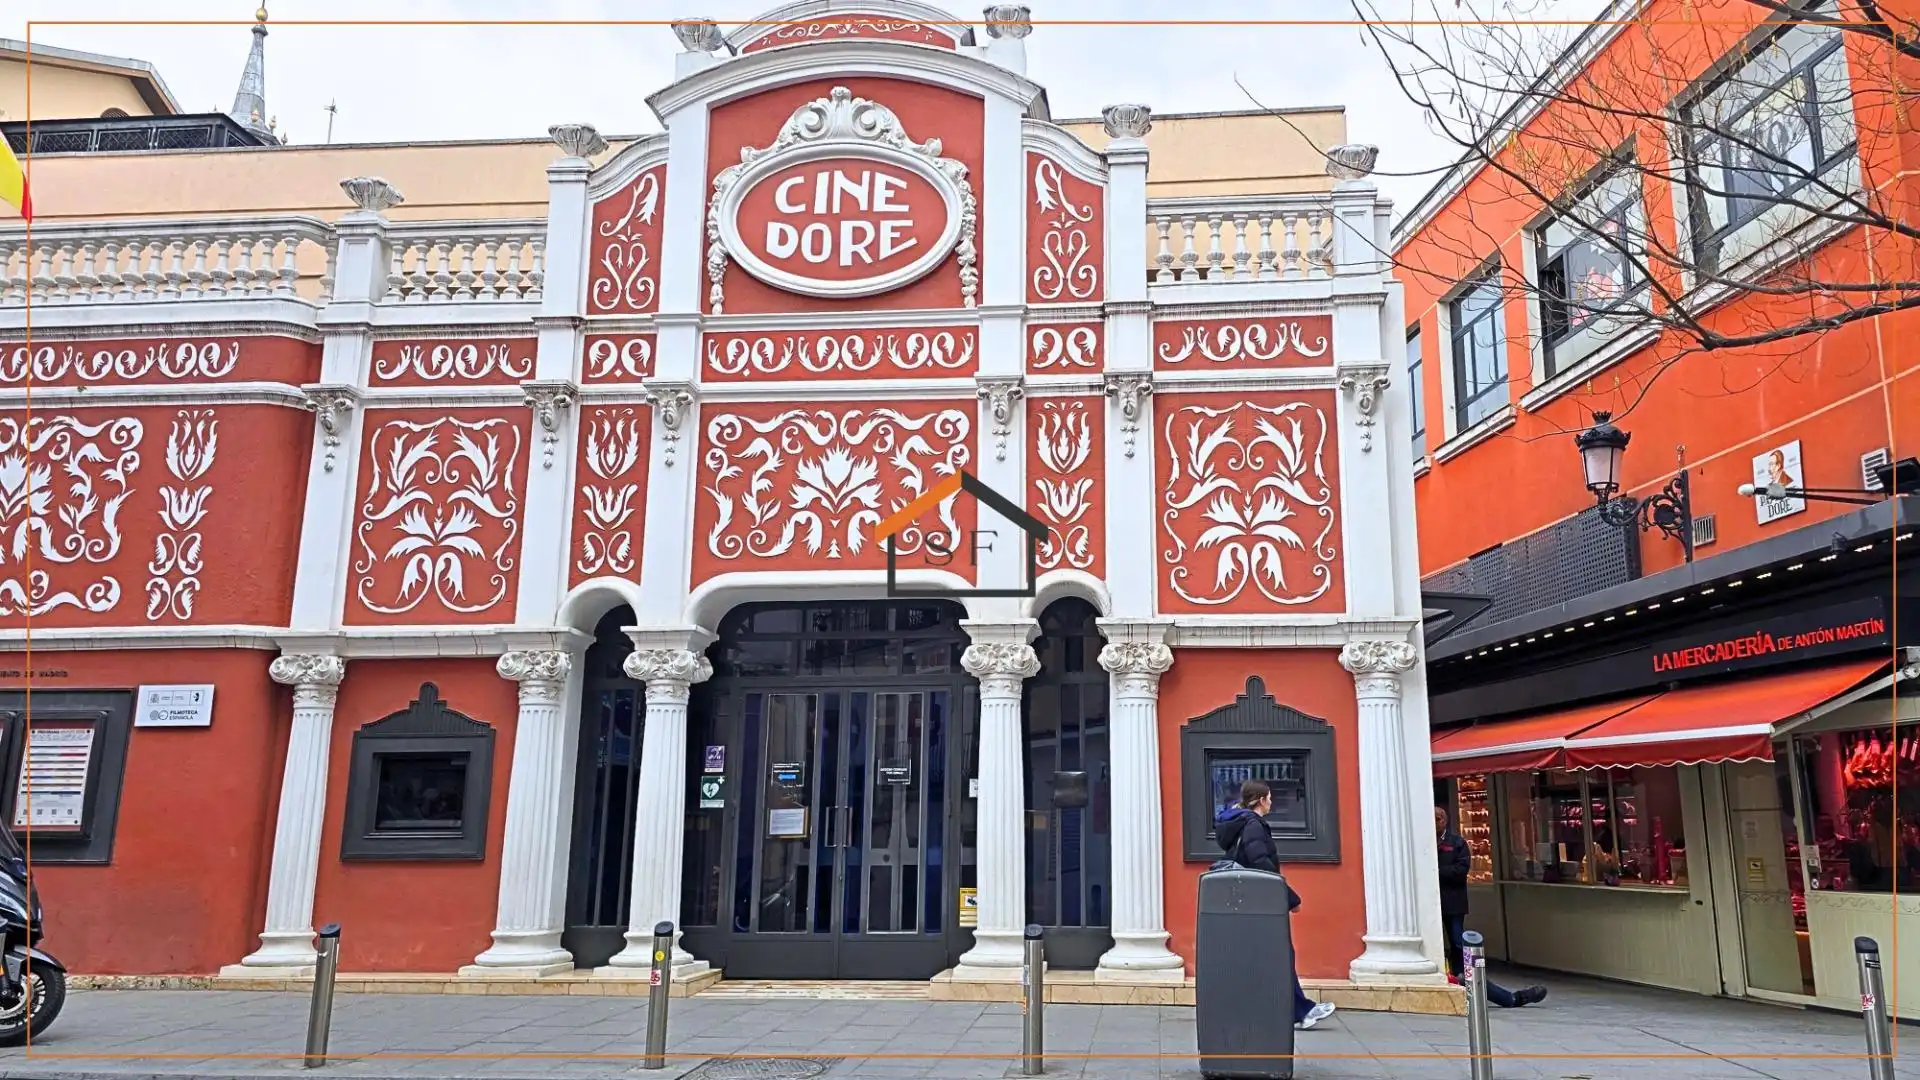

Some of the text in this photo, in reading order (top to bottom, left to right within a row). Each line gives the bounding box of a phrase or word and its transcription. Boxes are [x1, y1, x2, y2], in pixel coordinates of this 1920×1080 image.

[775, 170, 910, 214] CINE
[766, 220, 918, 267] DORE
[1653, 618, 1885, 673] LA MERCADERÍA DE ANTÓN MARTÍN
